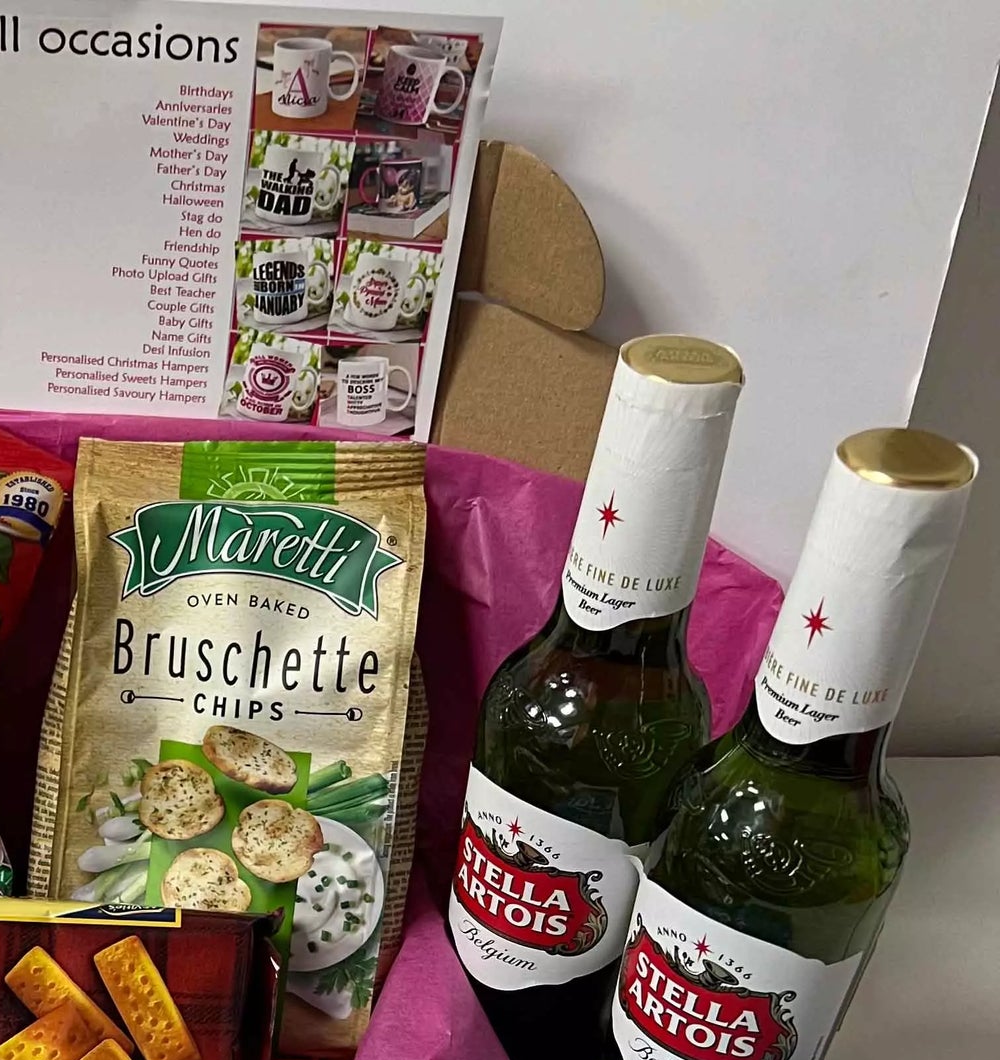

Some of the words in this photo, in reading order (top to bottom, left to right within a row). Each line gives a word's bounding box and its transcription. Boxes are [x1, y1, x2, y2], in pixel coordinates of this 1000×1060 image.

[39, 24, 239, 64] occasions
[179, 85, 233, 100] Birthdays
[155, 100, 232, 115] Anniversaries
[142, 114, 204, 128] Valentine's
[208, 118, 231, 132] Day
[173, 132, 229, 148] Weddings
[150, 147, 201, 160] Mother's
[205, 151, 228, 164] Day
[157, 163, 200, 176] Father's
[204, 166, 227, 180] Day
[263, 169, 284, 183] THE
[171, 180, 225, 193] Christmas
[261, 179, 314, 196] WALKING
[162, 194, 224, 208] Halloween
[257, 189, 312, 216] DAD
[164, 241, 220, 256] Friendship
[142, 254, 176, 269] Funny
[179, 257, 218, 270] Quotes
[253, 260, 305, 280] LEGENDS
[112, 267, 145, 280] Photo
[149, 270, 189, 283] Upload
[192, 271, 217, 284] Gifts
[260, 280, 294, 293] BORN
[41, 352, 104, 366] Personalised
[107, 357, 158, 370] Christmas
[161, 360, 209, 374] Hampers
[55, 368, 119, 382] Personalised
[121, 372, 157, 385] Sweets
[160, 376, 208, 390] Hampers
[347, 384, 376, 394] BOSS
[47, 382, 110, 397] Personalised
[113, 386, 156, 401] Savoury
[159, 390, 206, 404] Hampers
[240, 398, 284, 416] OCTOBER
[3, 493, 50, 518] 1980
[565, 569, 600, 601] Premium
[600, 593, 636, 610] Lager
[186, 592, 239, 610] OVEN
[249, 594, 311, 621] BAKED
[578, 598, 602, 616] Beer
[112, 617, 380, 695] Bruschette
[785, 671, 820, 697] FINE
[824, 687, 847, 704] DE
[852, 688, 889, 705] LUXE
[192, 692, 286, 722] CHIPS
[761, 676, 800, 711] Premium
[799, 703, 840, 722] Lager
[774, 708, 802, 727] Beer
[462, 838, 572, 913] STELLA
[457, 866, 569, 937] ARTOIS
[457, 917, 538, 972] Belgium
[656, 925, 688, 943] ANNO
[717, 953, 753, 981] 1366
[636, 950, 760, 1034] STELLA
[628, 978, 757, 1058] ARTOIS
